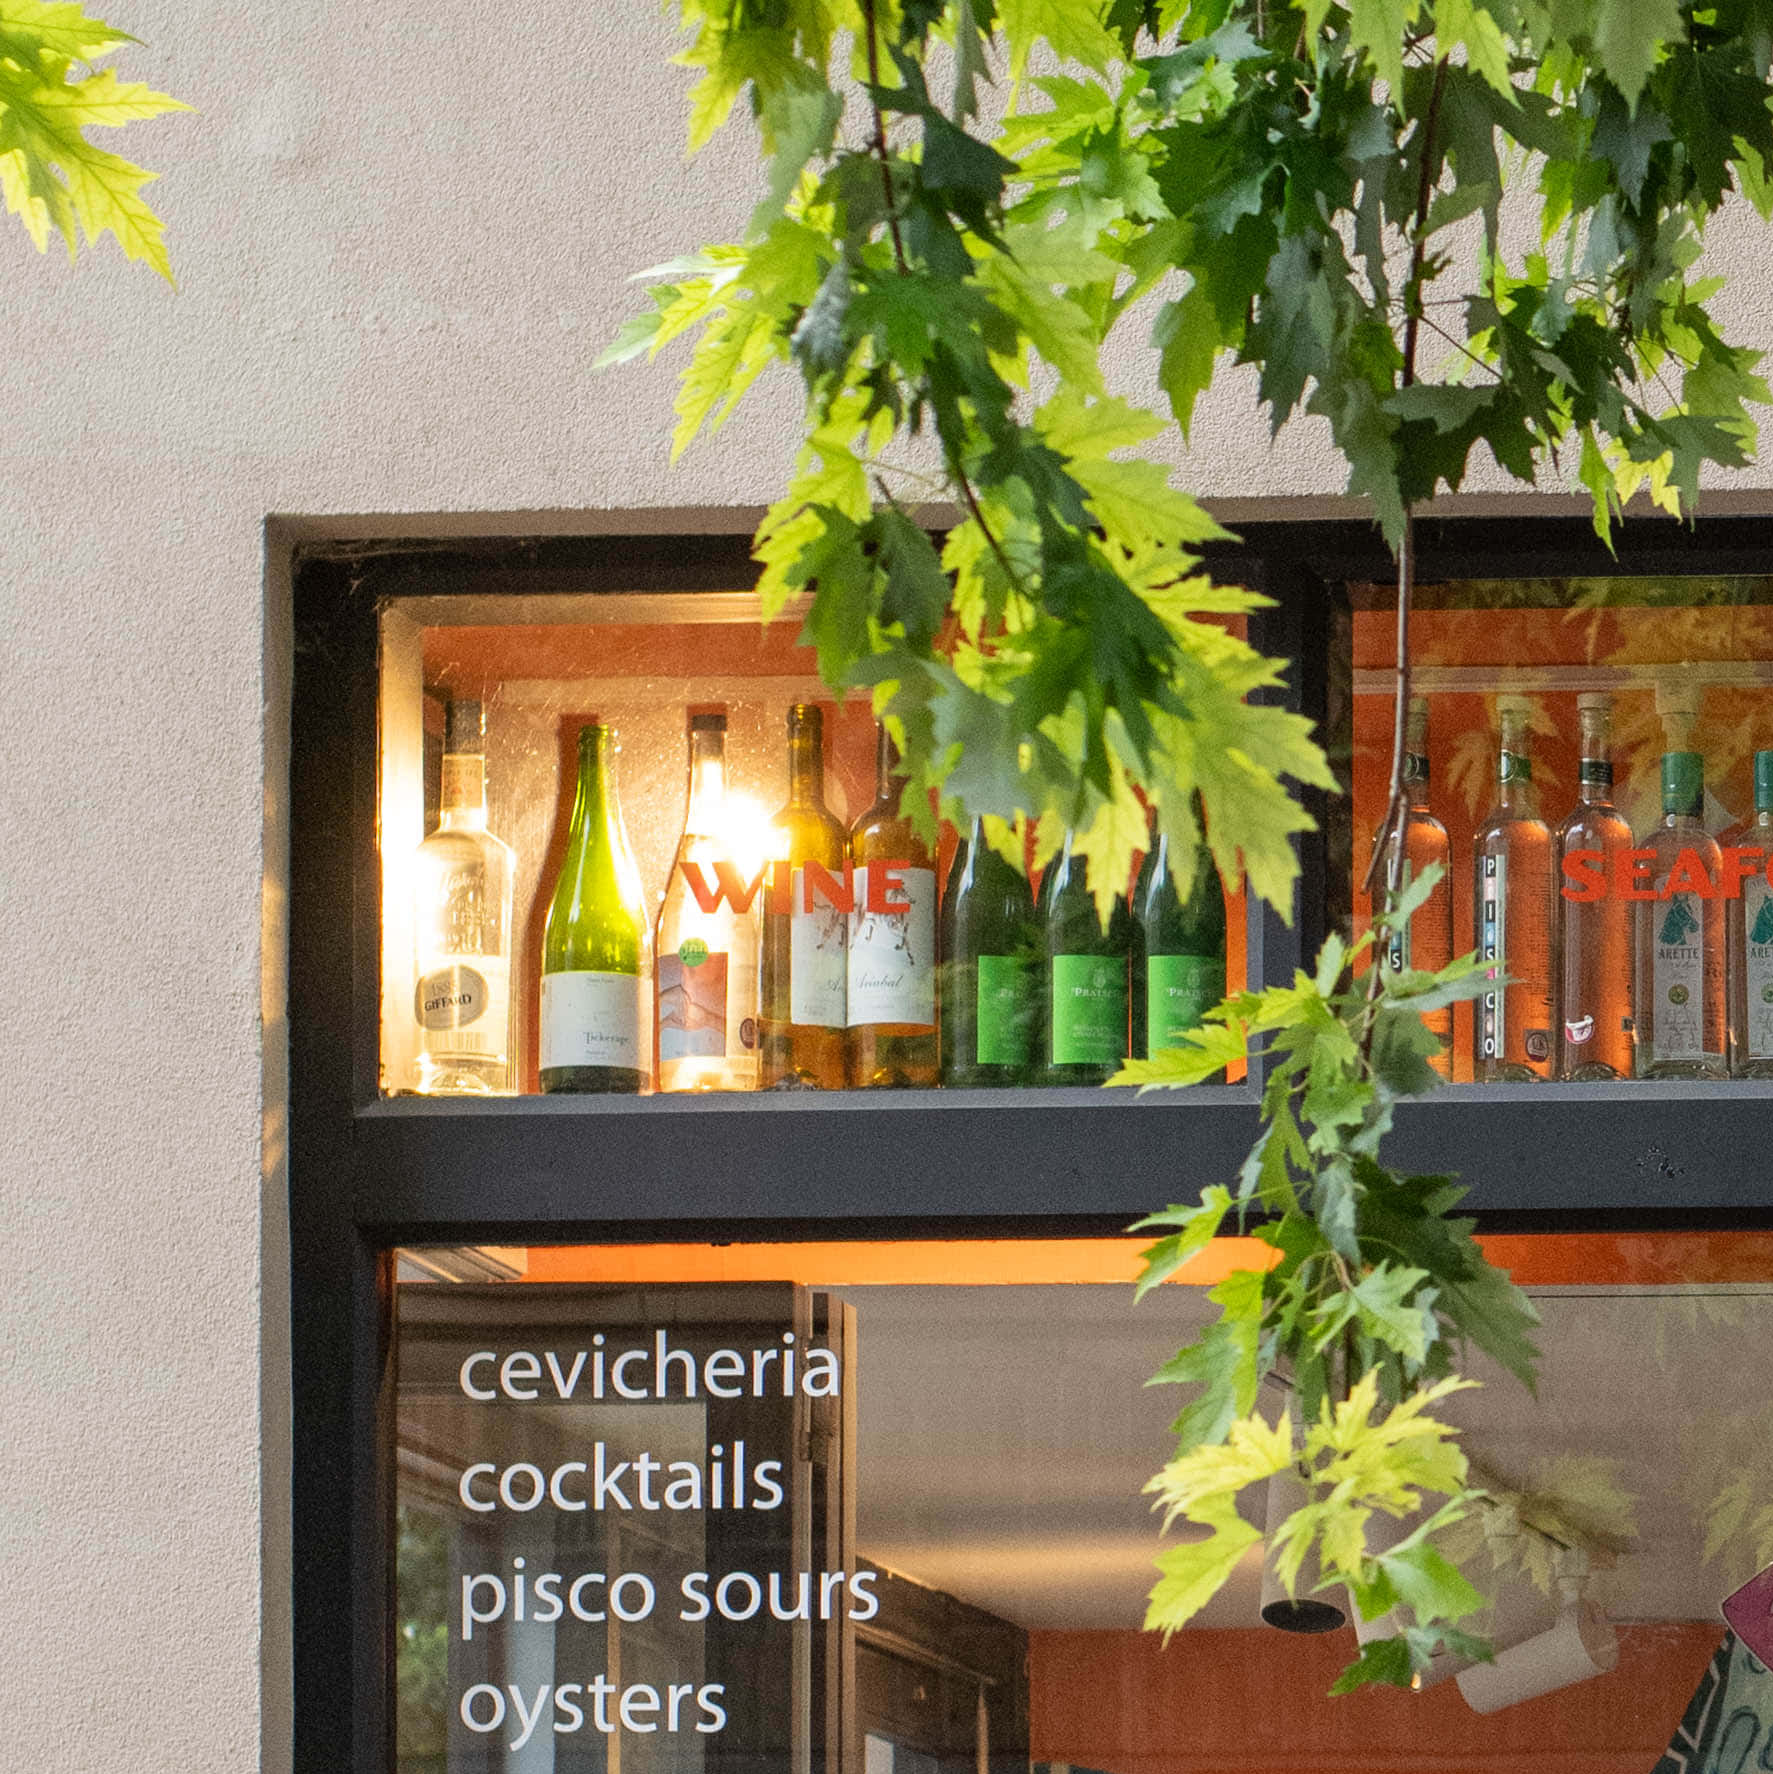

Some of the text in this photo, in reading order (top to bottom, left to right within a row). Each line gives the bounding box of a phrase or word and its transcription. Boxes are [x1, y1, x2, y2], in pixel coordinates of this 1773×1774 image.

[679, 859, 912, 914] WINE
[459, 1330, 840, 1400] cevicheria
[459, 1442, 784, 1512] cocktails
[461, 1557, 879, 1641] pisco sours
[459, 1674, 728, 1752] oysters
